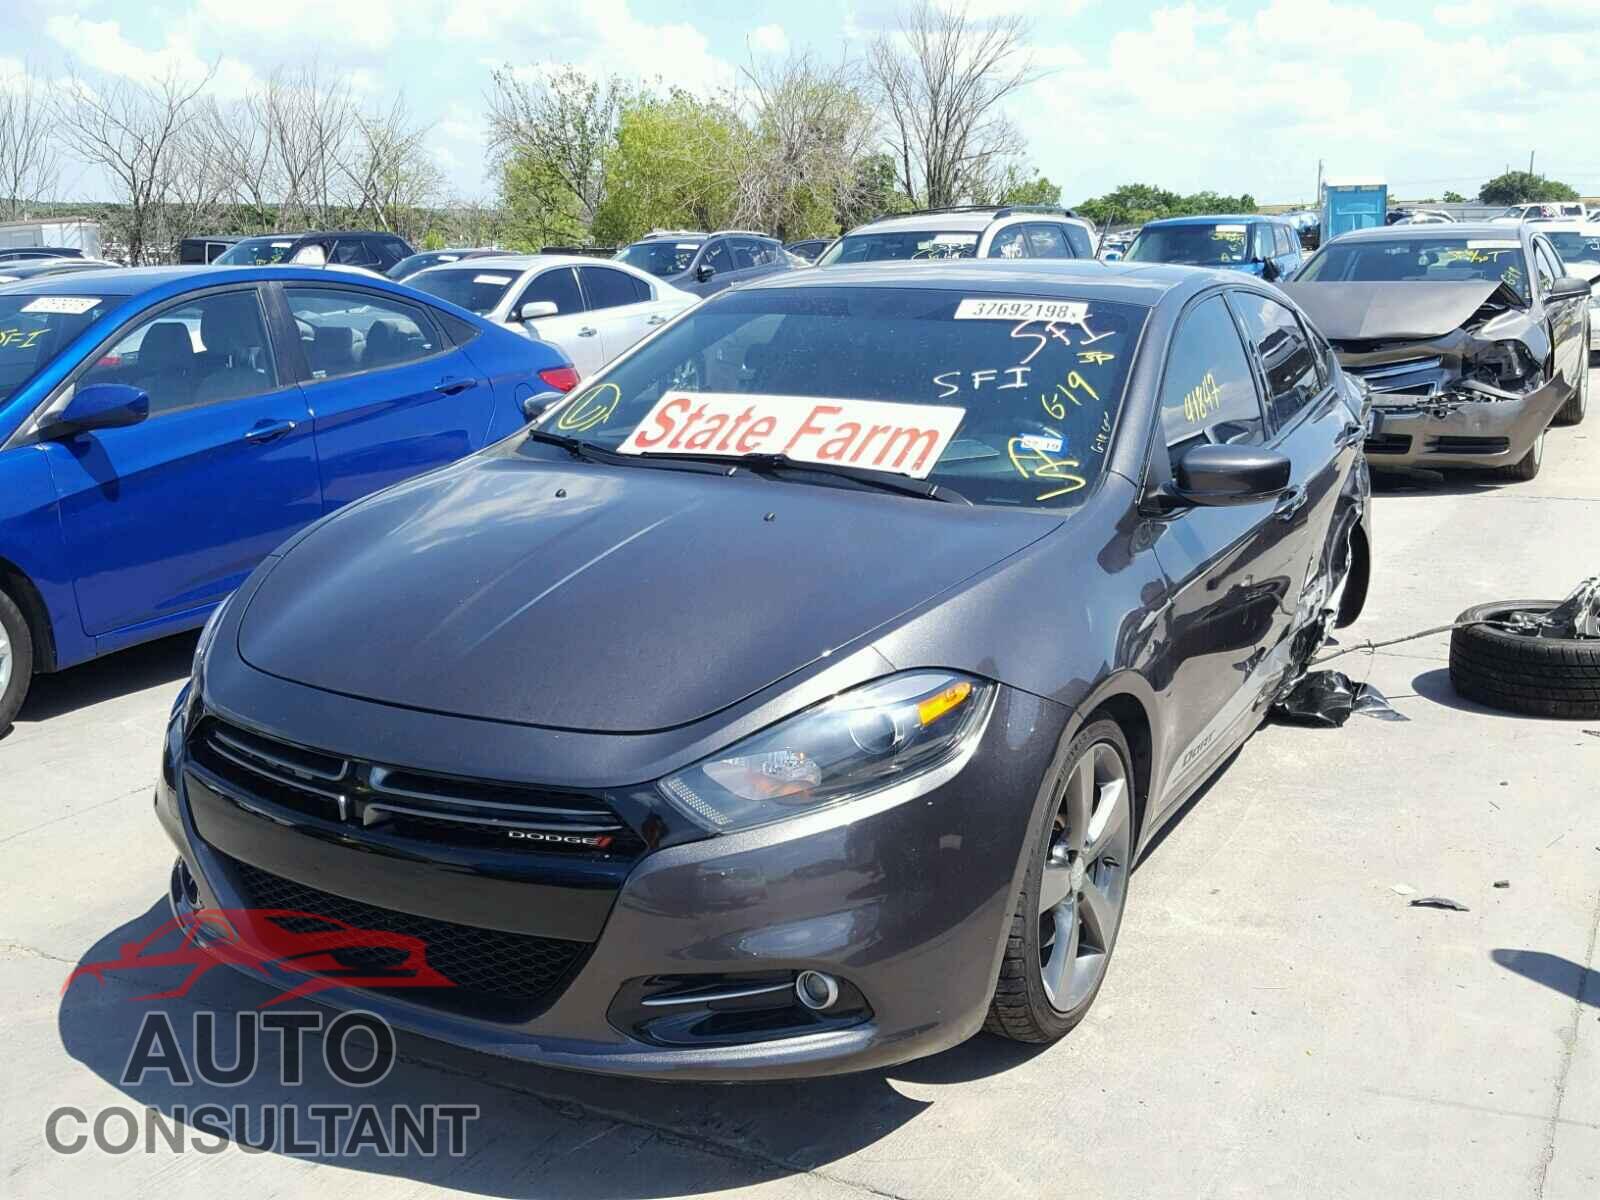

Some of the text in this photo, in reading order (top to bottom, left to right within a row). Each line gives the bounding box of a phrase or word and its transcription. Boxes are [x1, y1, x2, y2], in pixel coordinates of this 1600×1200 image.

[972, 302, 1069, 319] 37692198
[933, 367, 1032, 398] SFI
[634, 398, 940, 470] State Farm
[508, 830, 600, 846] DODGE
